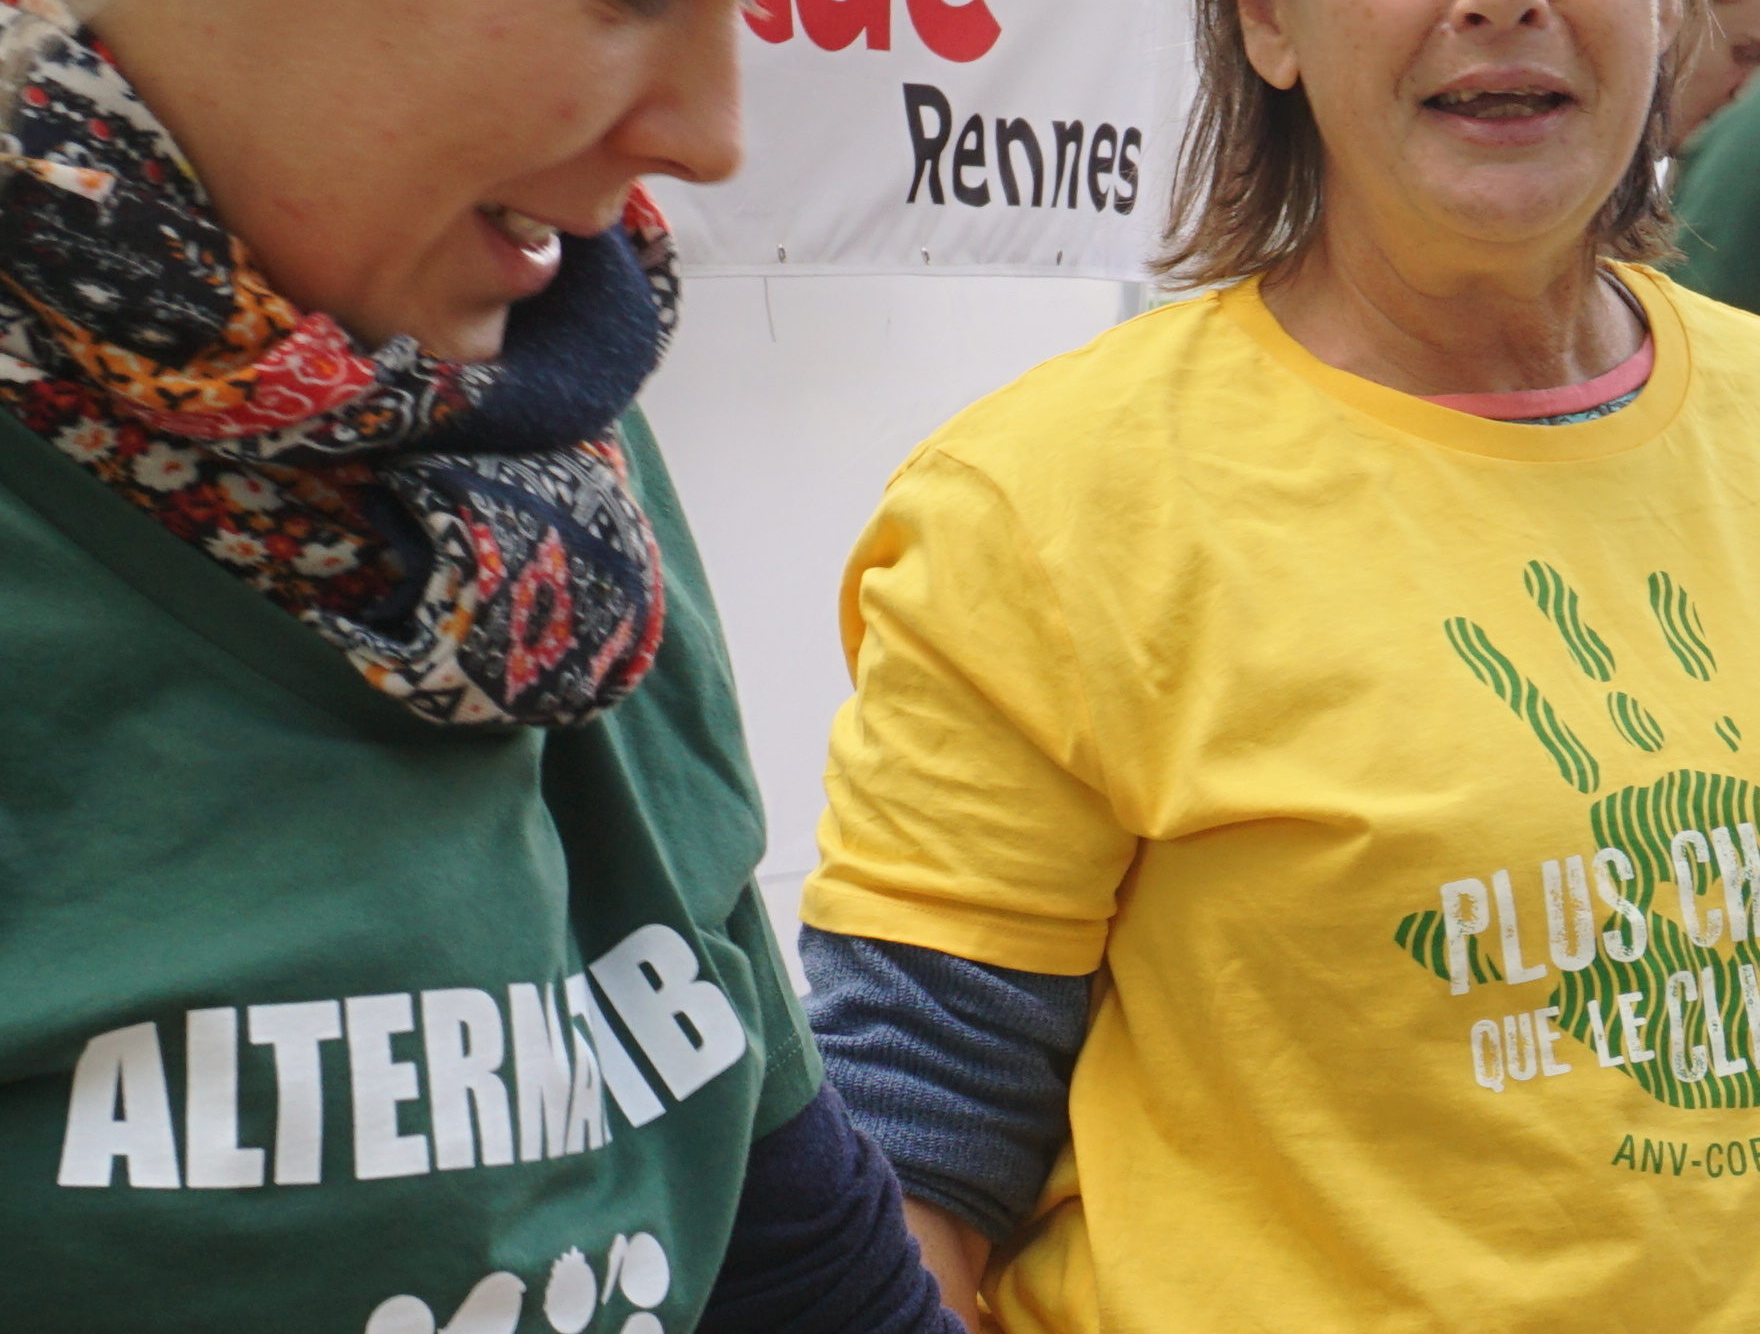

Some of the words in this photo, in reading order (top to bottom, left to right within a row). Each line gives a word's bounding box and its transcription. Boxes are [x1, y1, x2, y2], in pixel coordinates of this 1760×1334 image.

[902, 82, 1142, 216] Rennes
[1439, 846, 1648, 995] PLUS
[1469, 1004, 1572, 1093] QUE
[1588, 991, 1656, 1069] LE
